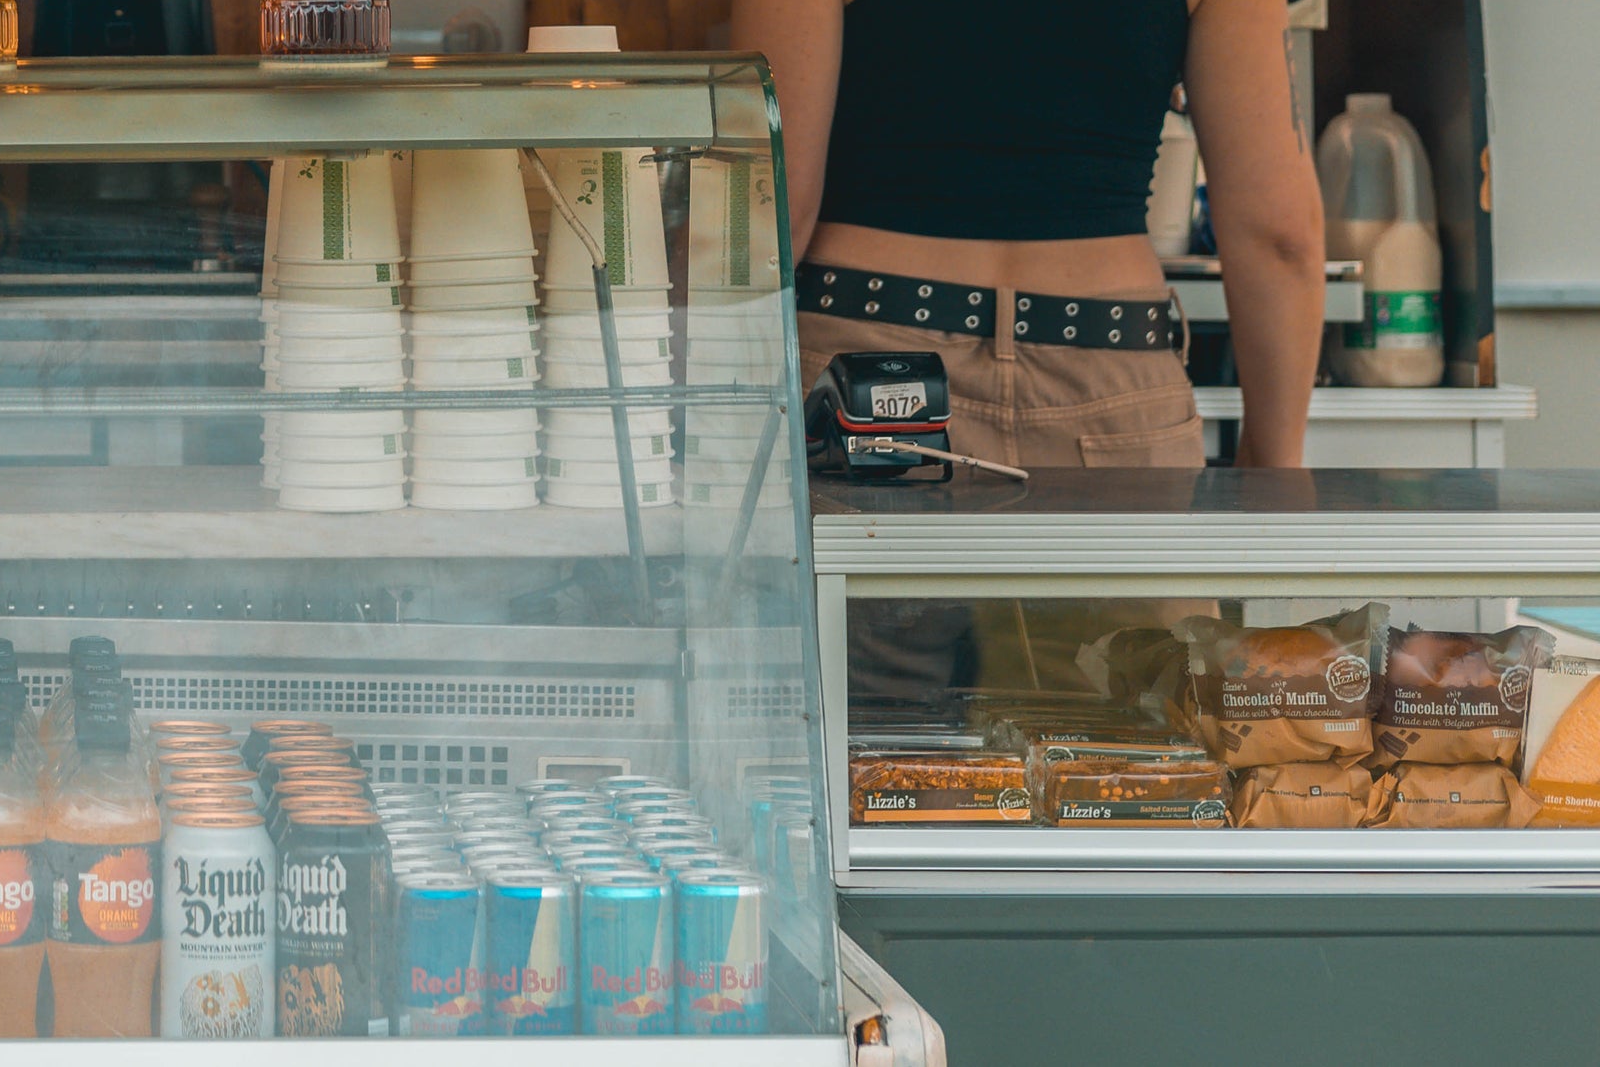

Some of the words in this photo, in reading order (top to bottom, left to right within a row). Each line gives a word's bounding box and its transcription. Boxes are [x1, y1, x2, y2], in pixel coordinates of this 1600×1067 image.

[1222, 682, 1248, 692] Lizzie's
[1395, 688, 1422, 699] Lizzie's
[1222, 693, 1282, 707] Chocolate
[1286, 691, 1327, 705] Muffin
[1224, 709, 1251, 718] Made
[1252, 709, 1269, 718] with
[1303, 708, 1343, 717] chocolate
[1394, 700, 1456, 716] Chocolate
[1460, 702, 1499, 716] Muffin
[1393, 716, 1421, 726] Made
[1422, 717, 1441, 727] with
[1442, 718, 1475, 730] Belgian
[867, 794, 916, 809] Lizzie's
[973, 793, 994, 802] Honey
[1002, 797, 1031, 811] Lizzie's
[1063, 805, 1112, 819] Lizzie's
[174, 855, 266, 909] Liquid
[78, 872, 154, 909] Tango
[99, 909, 139, 922] ORANGE
[180, 897, 266, 938] Death
[180, 942, 231, 953] MOUNTAIN
[233, 942, 263, 952] WATER
[411, 966, 462, 995] Red
[522, 966, 567, 994] Bull
[592, 966, 641, 994] Red
[720, 962, 763, 991] Bull
